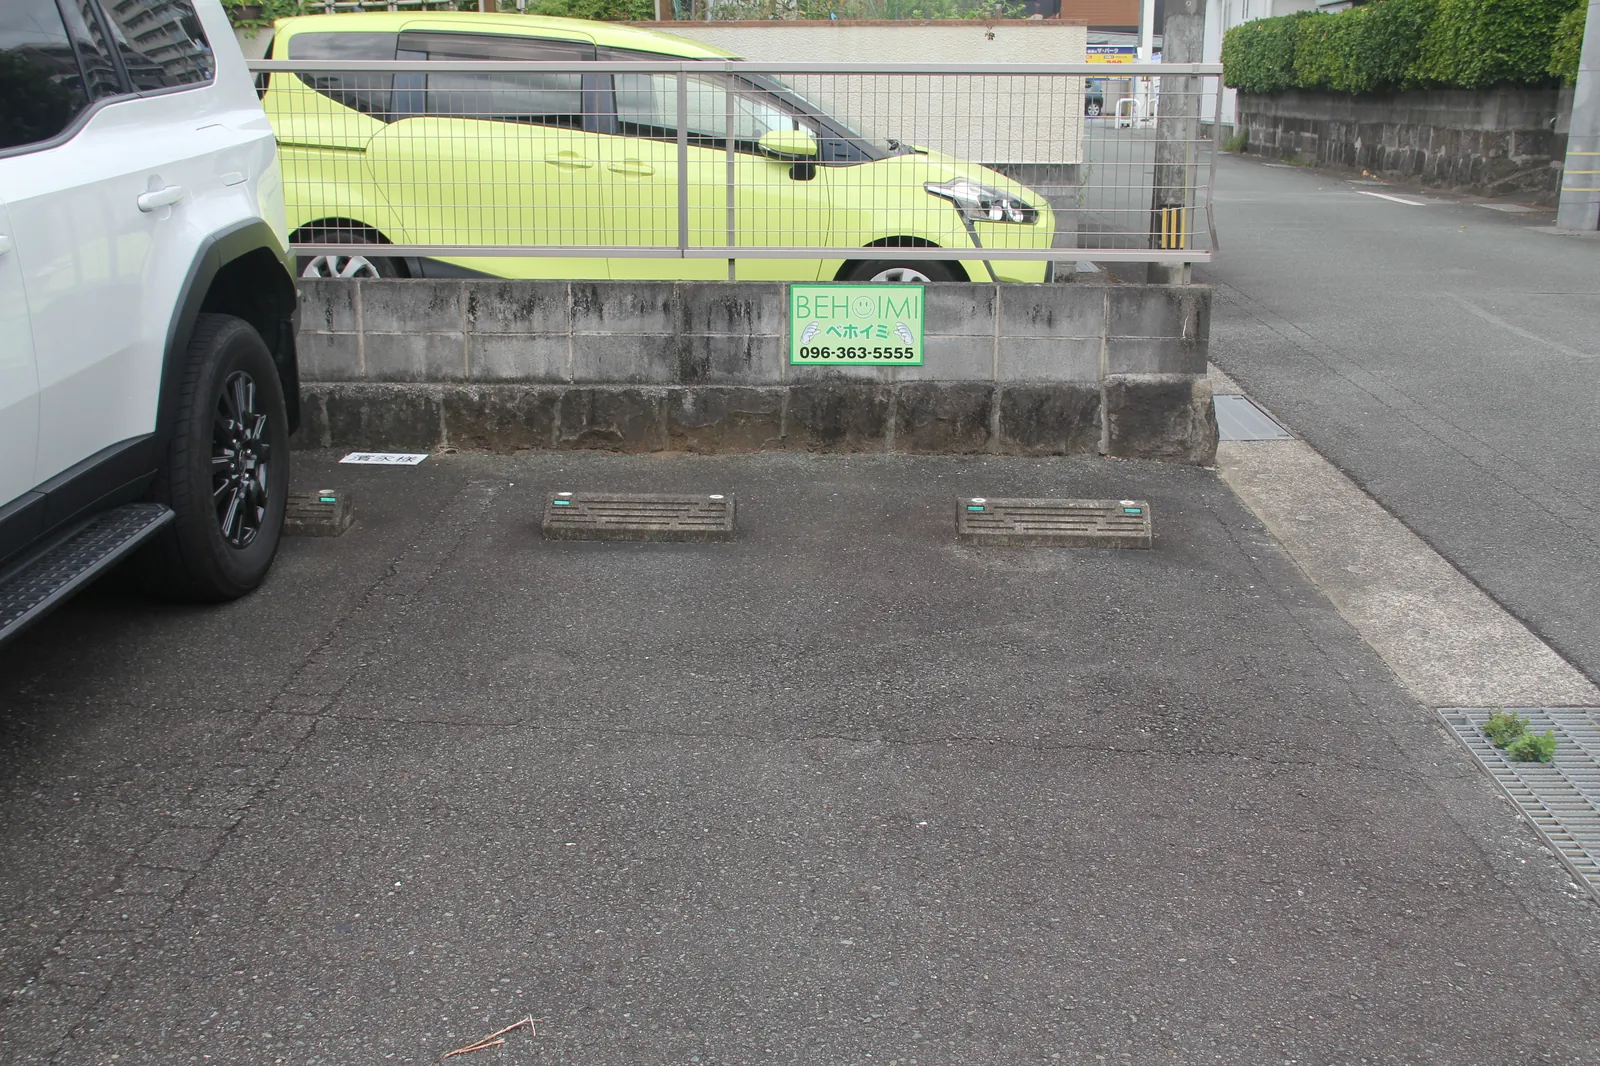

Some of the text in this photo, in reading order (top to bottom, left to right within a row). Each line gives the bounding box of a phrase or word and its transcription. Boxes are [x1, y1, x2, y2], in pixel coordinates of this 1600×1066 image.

[826, 324, 889, 339] ベホイミ
[799, 346, 914, 360] 096-363-5555
